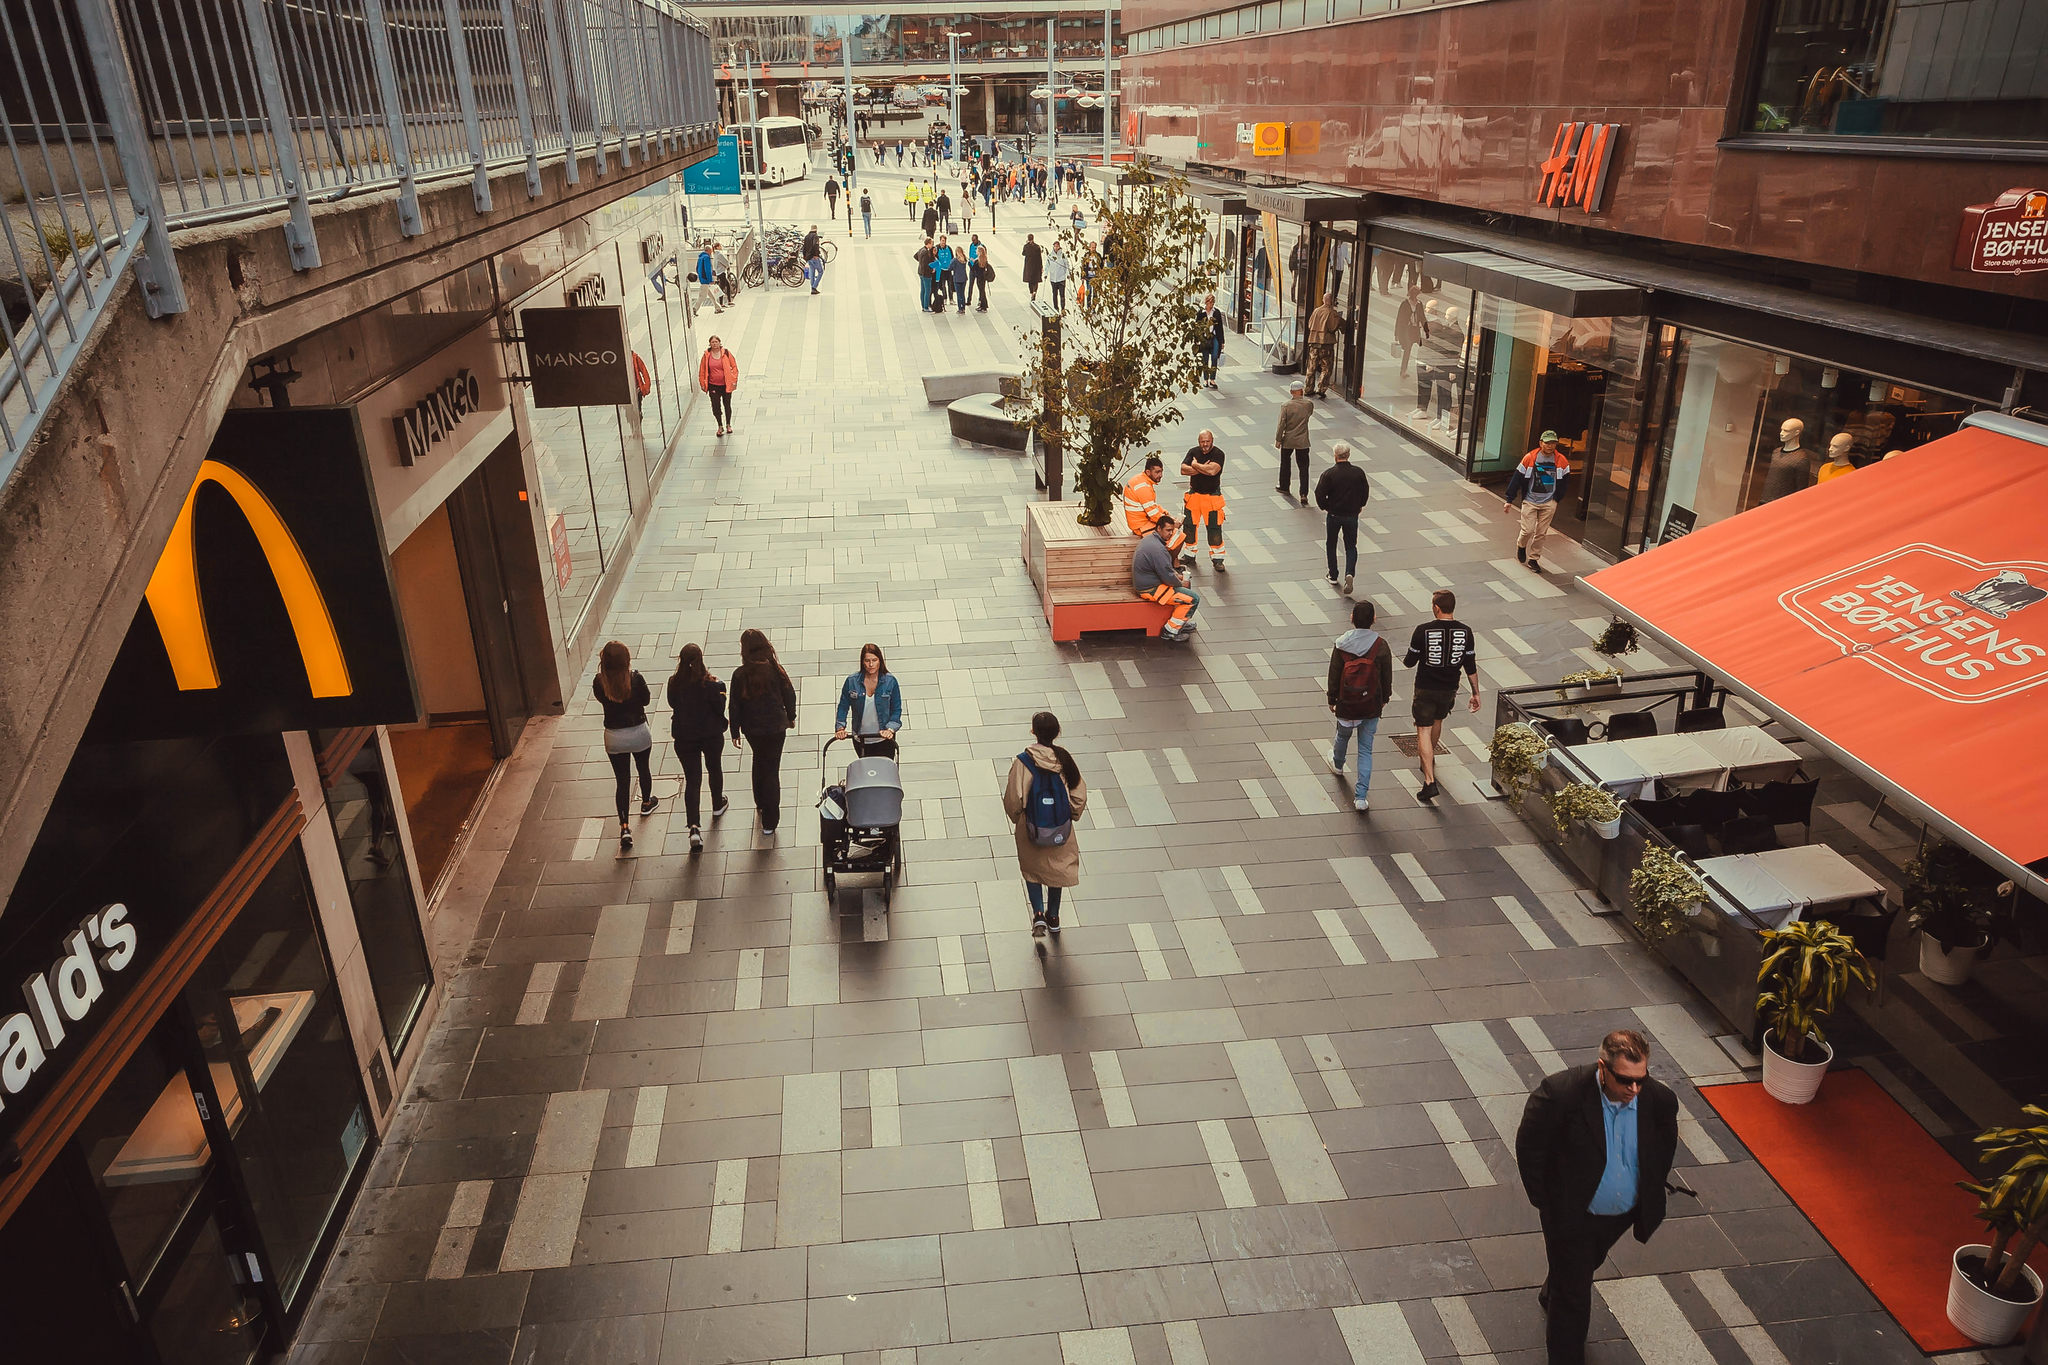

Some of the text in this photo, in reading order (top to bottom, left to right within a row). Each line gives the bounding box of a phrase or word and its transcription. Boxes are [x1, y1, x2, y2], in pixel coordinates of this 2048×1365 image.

[1536, 121, 1612, 214] H&M
[1982, 220, 2048, 239] JENSE
[535, 350, 618, 367] MANGO
[393, 368, 480, 467] MANGO
[1819, 591, 1995, 680] BØFHUS
[1854, 574, 2047, 666] JENSENS
[0, 903, 137, 1112] ald's
